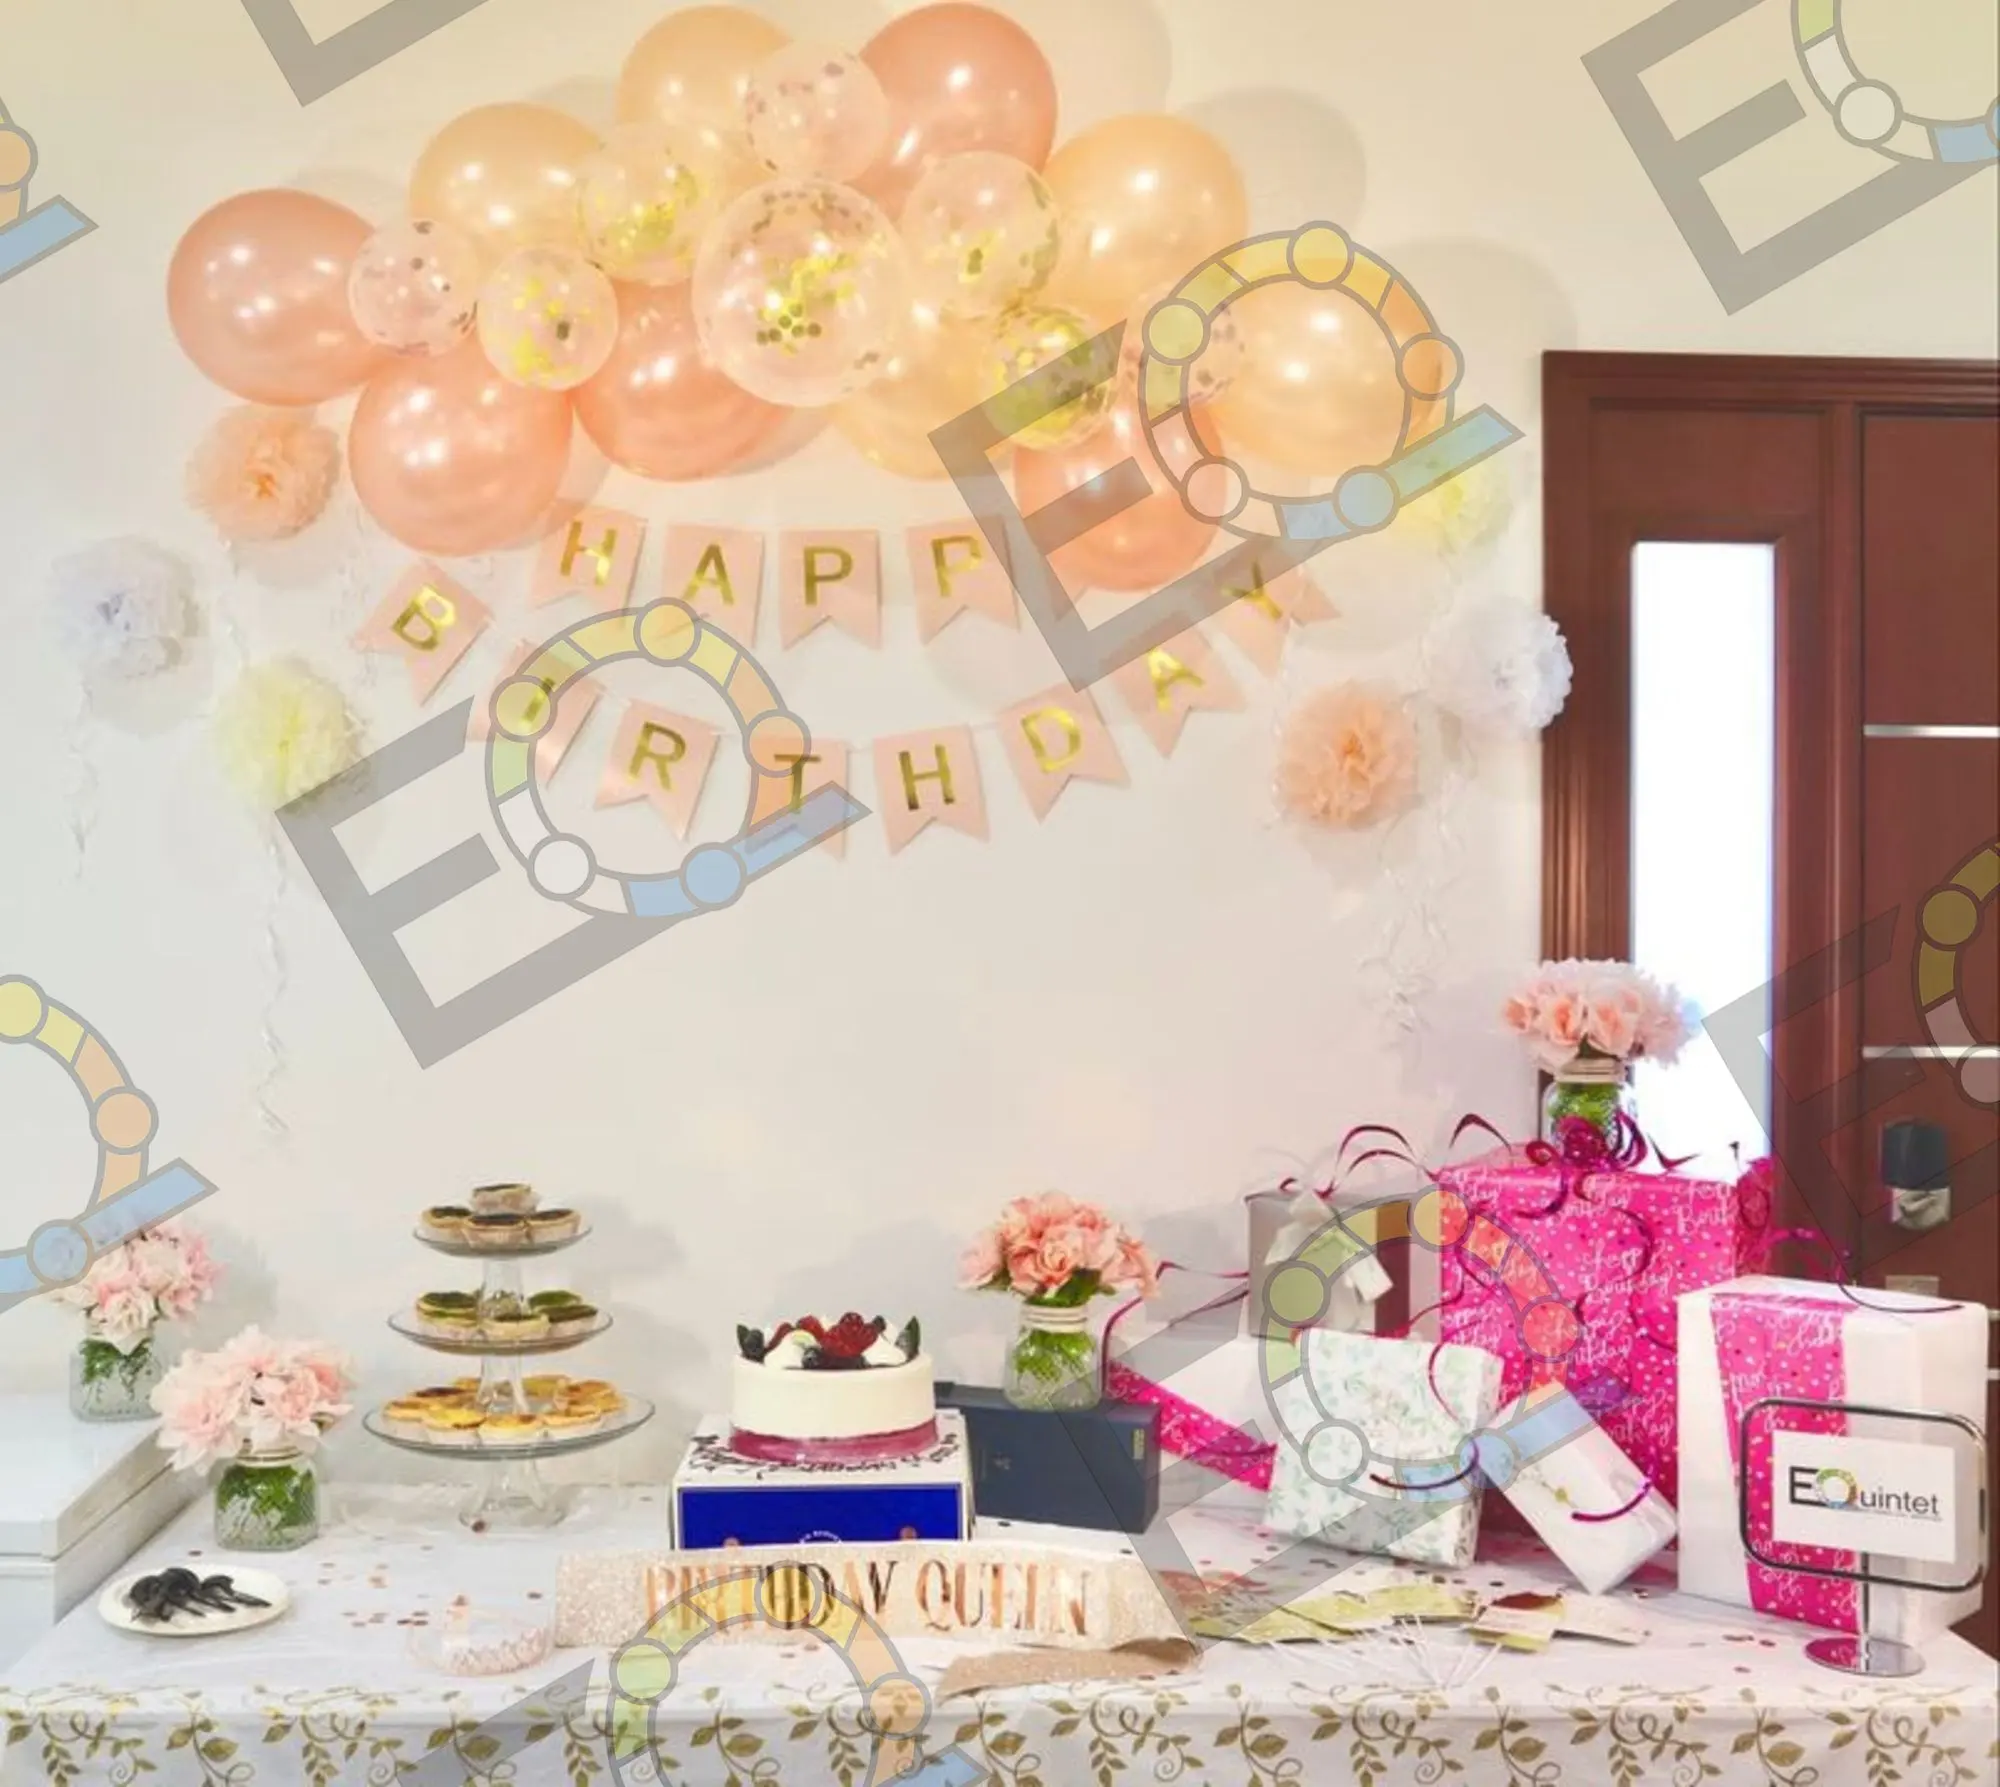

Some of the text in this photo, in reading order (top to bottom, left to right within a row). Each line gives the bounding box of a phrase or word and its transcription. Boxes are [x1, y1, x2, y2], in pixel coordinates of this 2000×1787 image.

[558, 520, 983, 607] HAPP
[390, 560, 1282, 813] BIRTHDAY
[1789, 1465, 1940, 1516] EQuintet
[645, 1558, 1090, 1636] BIRTHDAY QUEEN
